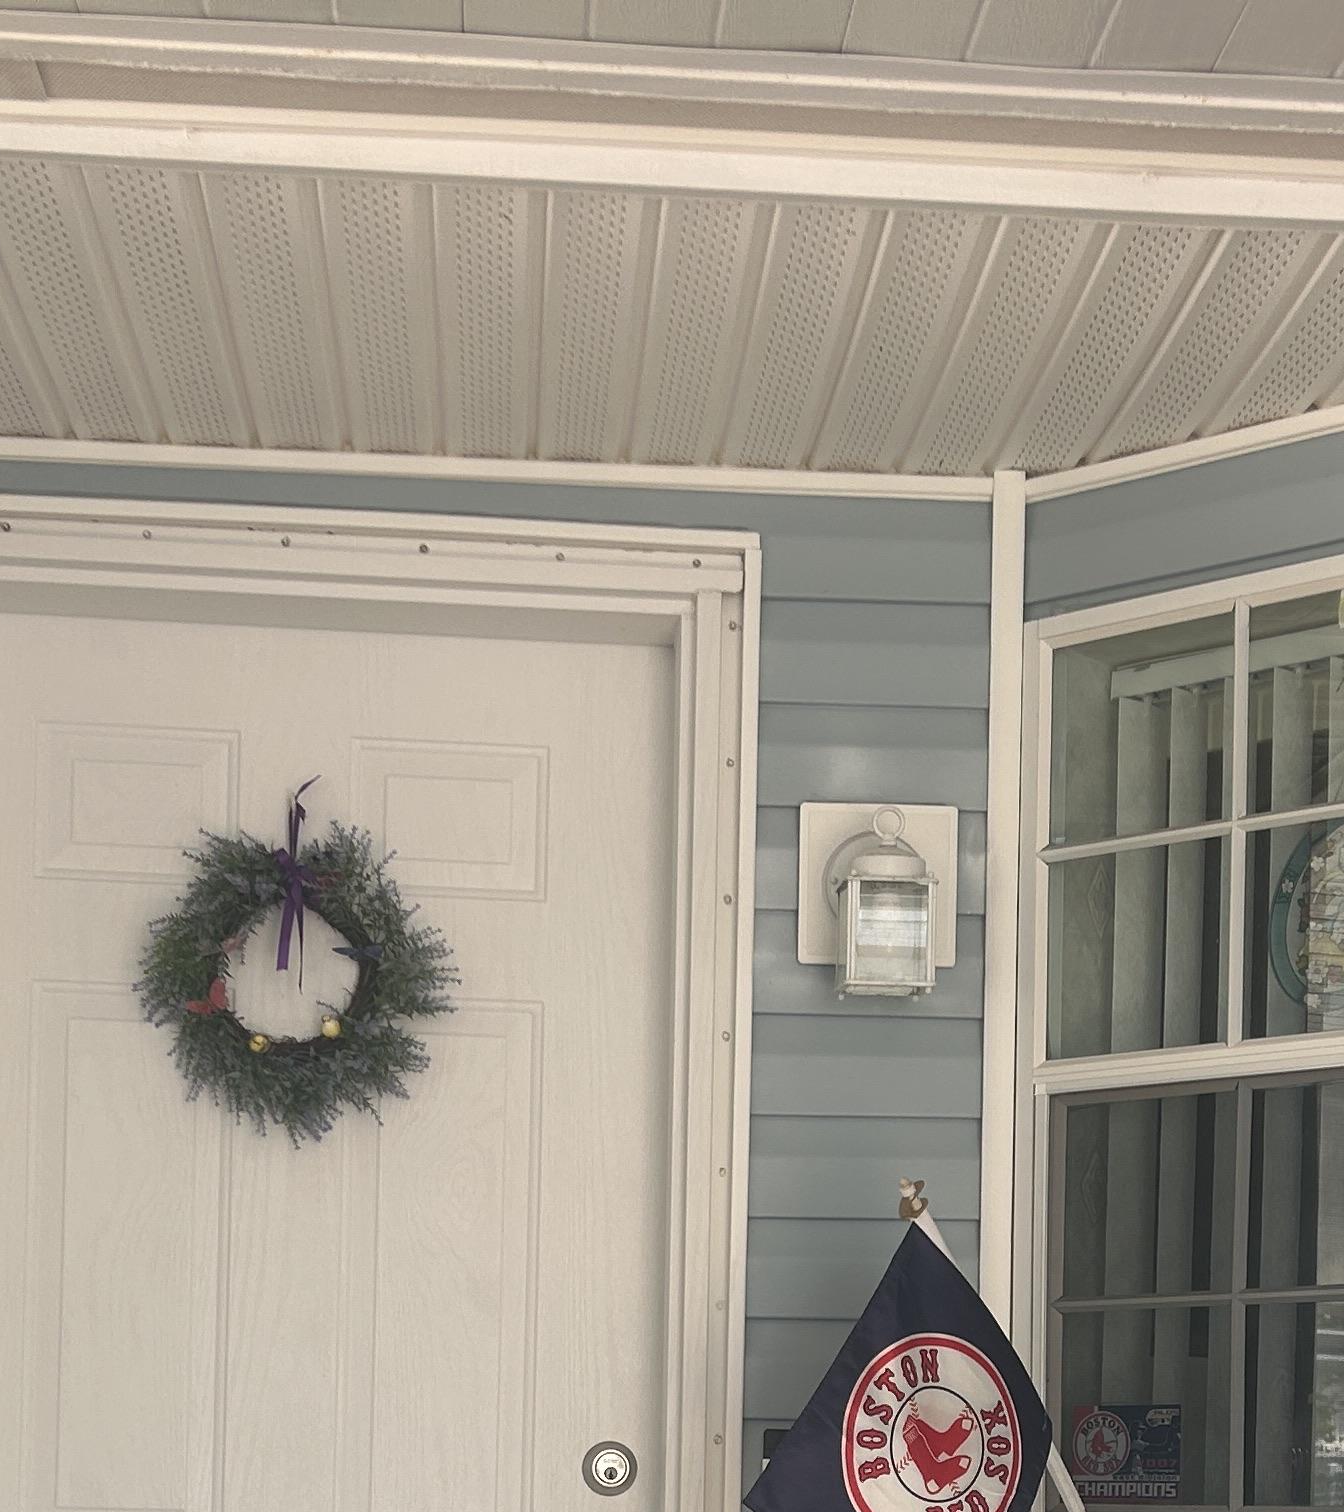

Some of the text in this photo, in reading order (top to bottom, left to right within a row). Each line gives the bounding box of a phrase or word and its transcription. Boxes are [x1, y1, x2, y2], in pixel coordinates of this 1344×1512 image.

[856, 1348, 941, 1483] BOSTON
[1080, 1416, 1124, 1437] BOSTON
[980, 1400, 1011, 1485] SOX
[1076, 1482, 1177, 1497] CHAMPIONS
